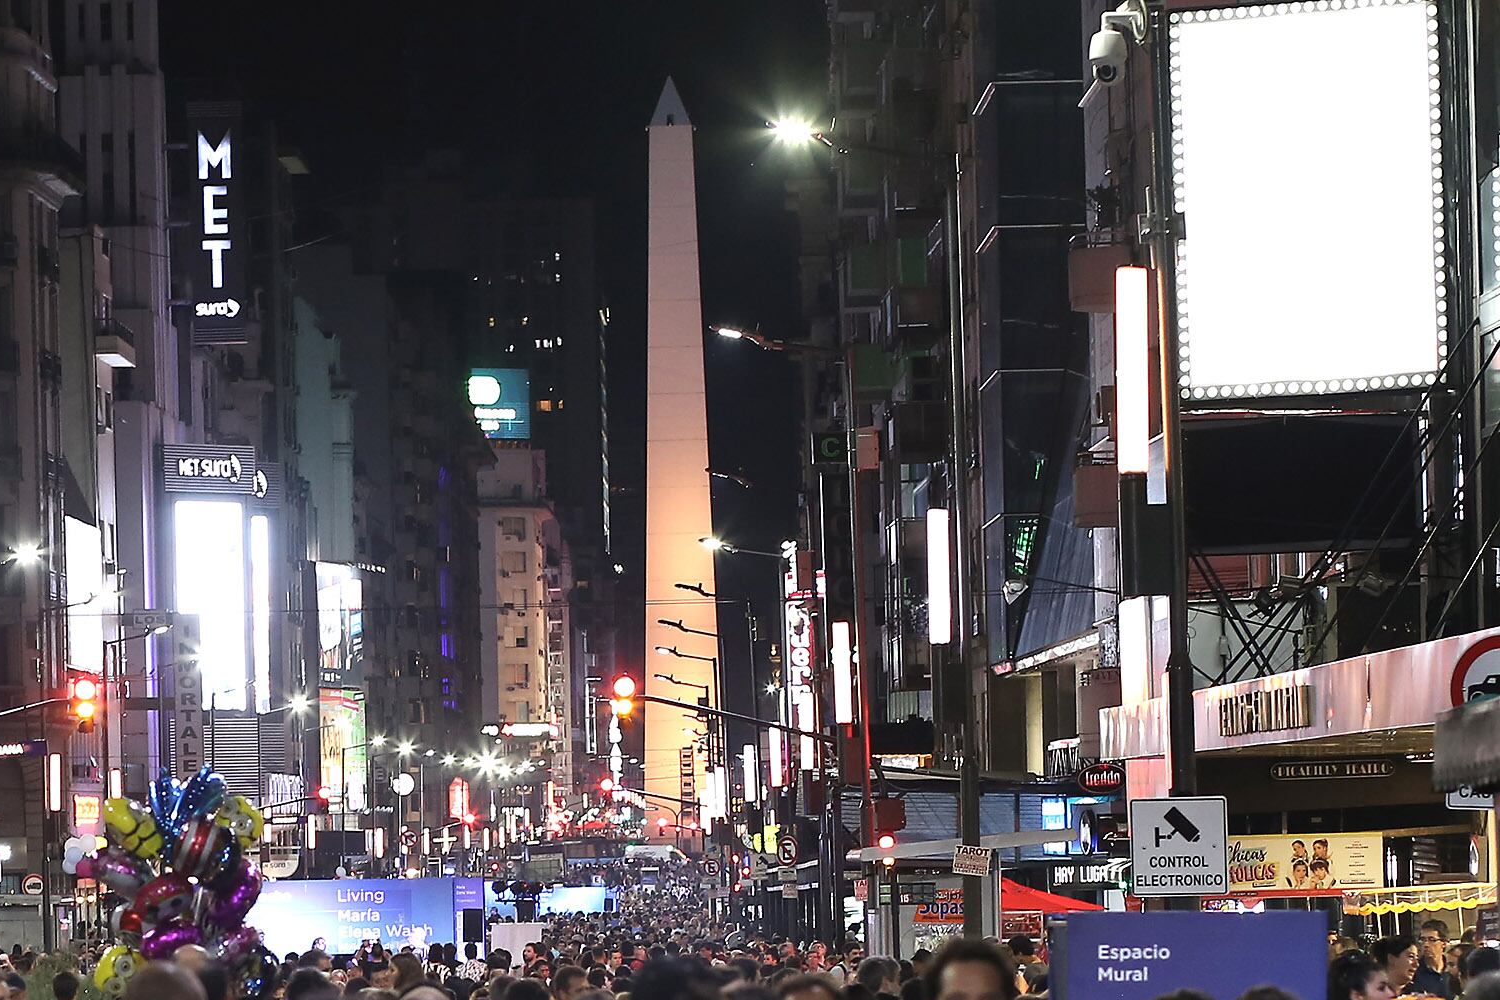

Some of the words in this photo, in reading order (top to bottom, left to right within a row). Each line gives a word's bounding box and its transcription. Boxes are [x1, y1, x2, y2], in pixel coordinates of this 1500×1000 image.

[197, 129, 232, 288] MET
[134, 615, 167, 626] LOS
[177, 624, 199, 773] INMORTALE
[1344, 763, 1389, 775] TEATRO
[1085, 769, 1121, 786] freddo
[955, 845, 990, 857] TAROT
[1149, 855, 1209, 868] CONTROL
[1054, 866, 1075, 884] HAY
[1136, 874, 1223, 887] ELECTRONICO
[337, 889, 385, 904] Living
[338, 907, 380, 923] María
[386, 923, 433, 938] Walh
[1097, 944, 1171, 962] Espacio
[1097, 966, 1149, 982] Mural
